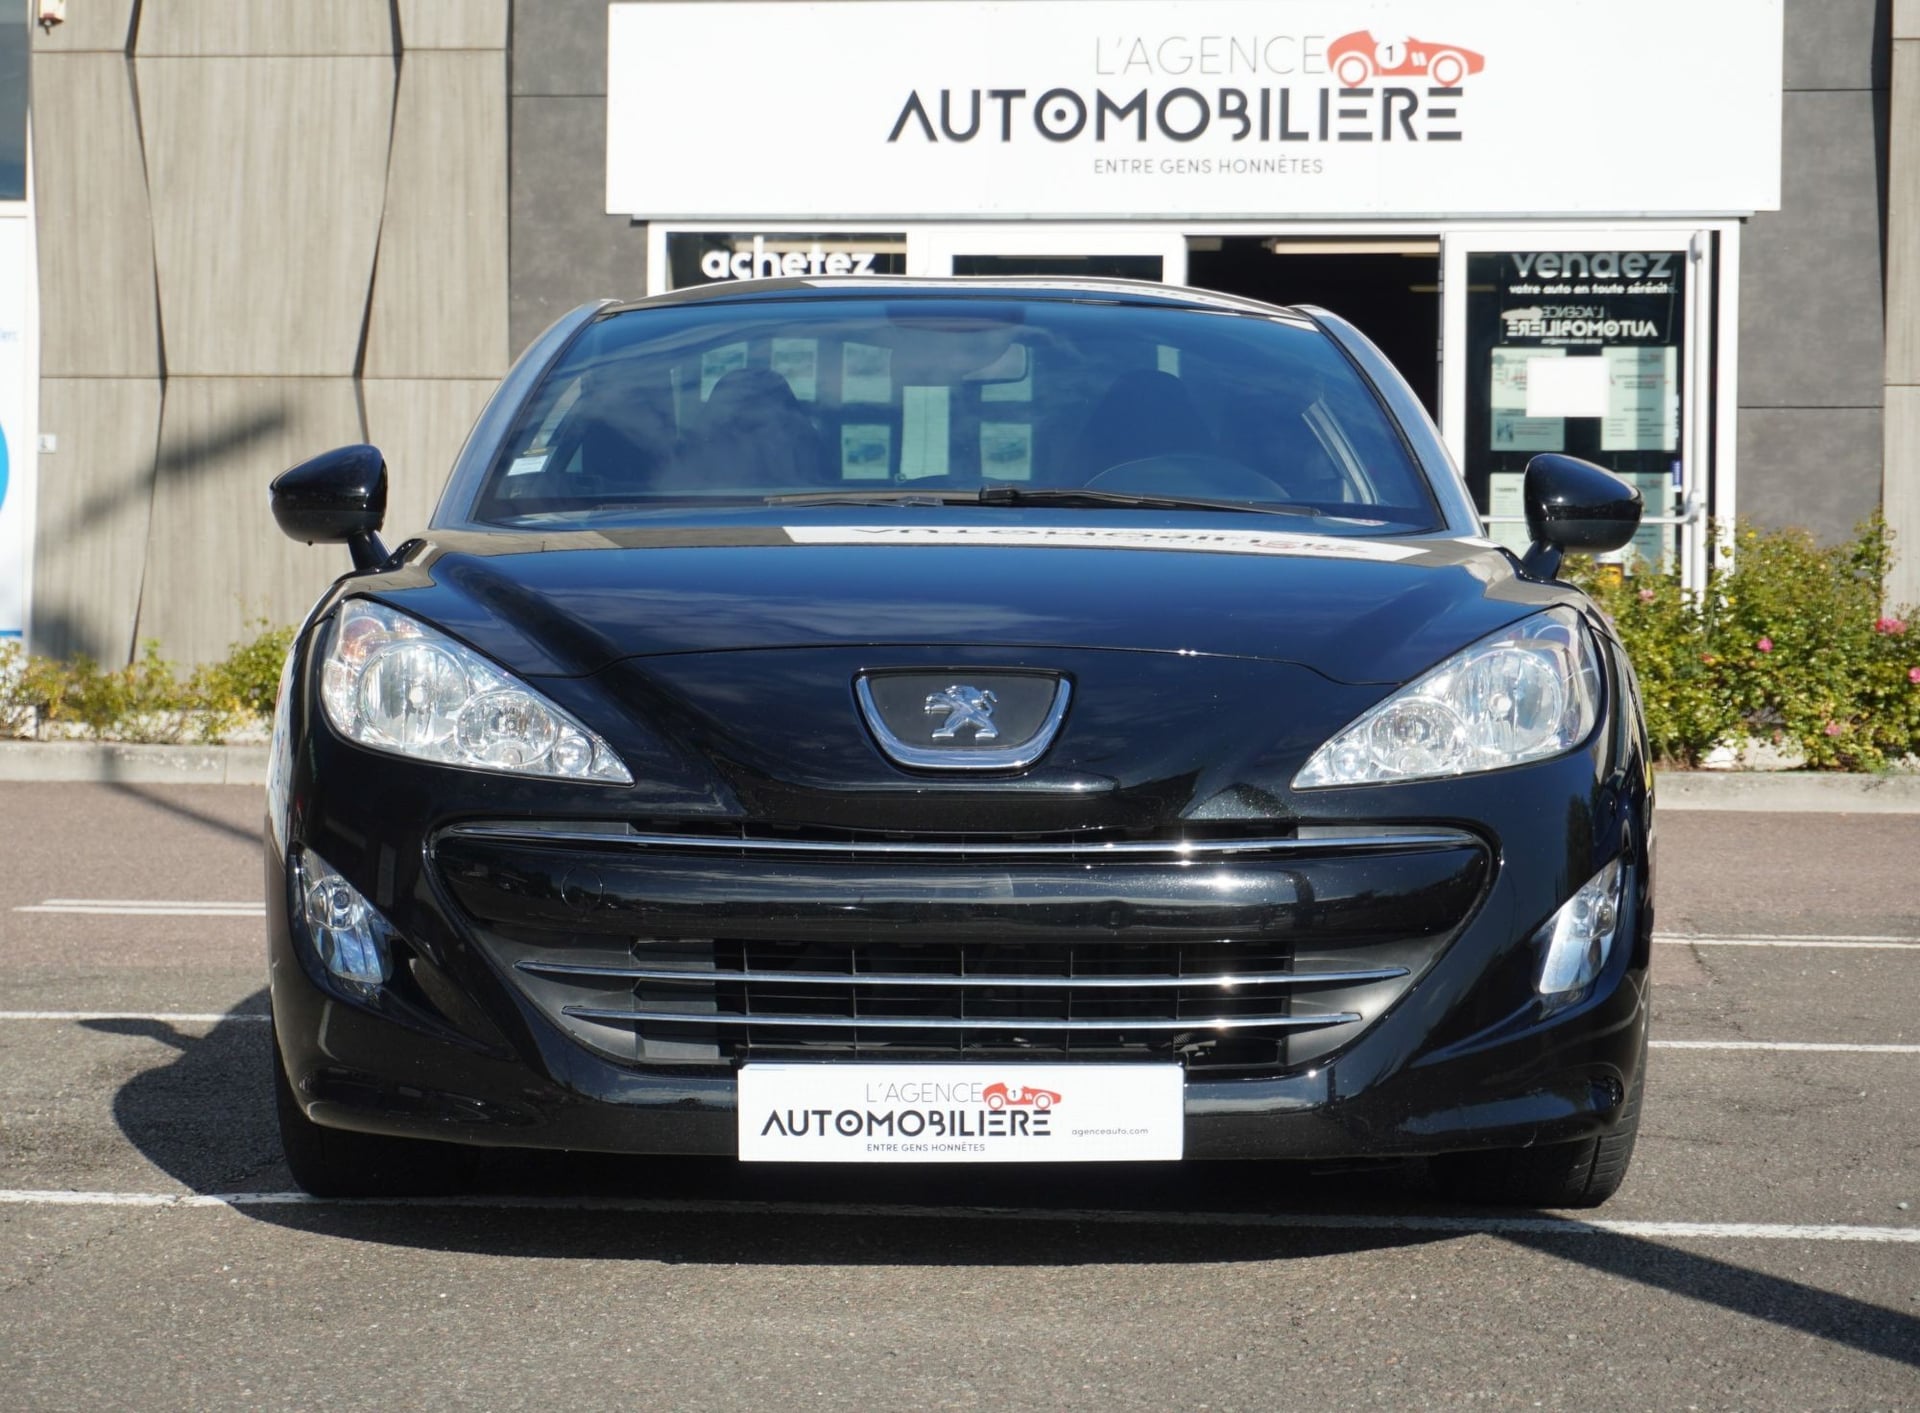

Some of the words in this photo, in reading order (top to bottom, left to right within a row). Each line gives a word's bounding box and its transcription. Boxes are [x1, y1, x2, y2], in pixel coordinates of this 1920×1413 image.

[1096, 36, 1326, 75] L'AGENCE
[887, 86, 1463, 143] AUTOMOBILIERE
[1094, 158, 1154, 174] ENTRE
[1160, 158, 1212, 174] GENS
[1218, 154, 1323, 174] HONNÊTES
[701, 235, 876, 279] achetez
[1509, 283, 1541, 295] votre
[1543, 283, 1571, 295] auto
[1573, 285, 1590, 295] en
[1592, 282, 1625, 295] toute
[866, 1082, 982, 1103] L'AGENCE
[761, 1109, 1052, 1137] AUTOMOBILIERE
[1071, 1127, 1149, 1138] agenceauto.com
[866, 1143, 899, 1152] ENTRE
[901, 1143, 929, 1152] GENS
[931, 1141, 986, 1152] HONNÊTES
